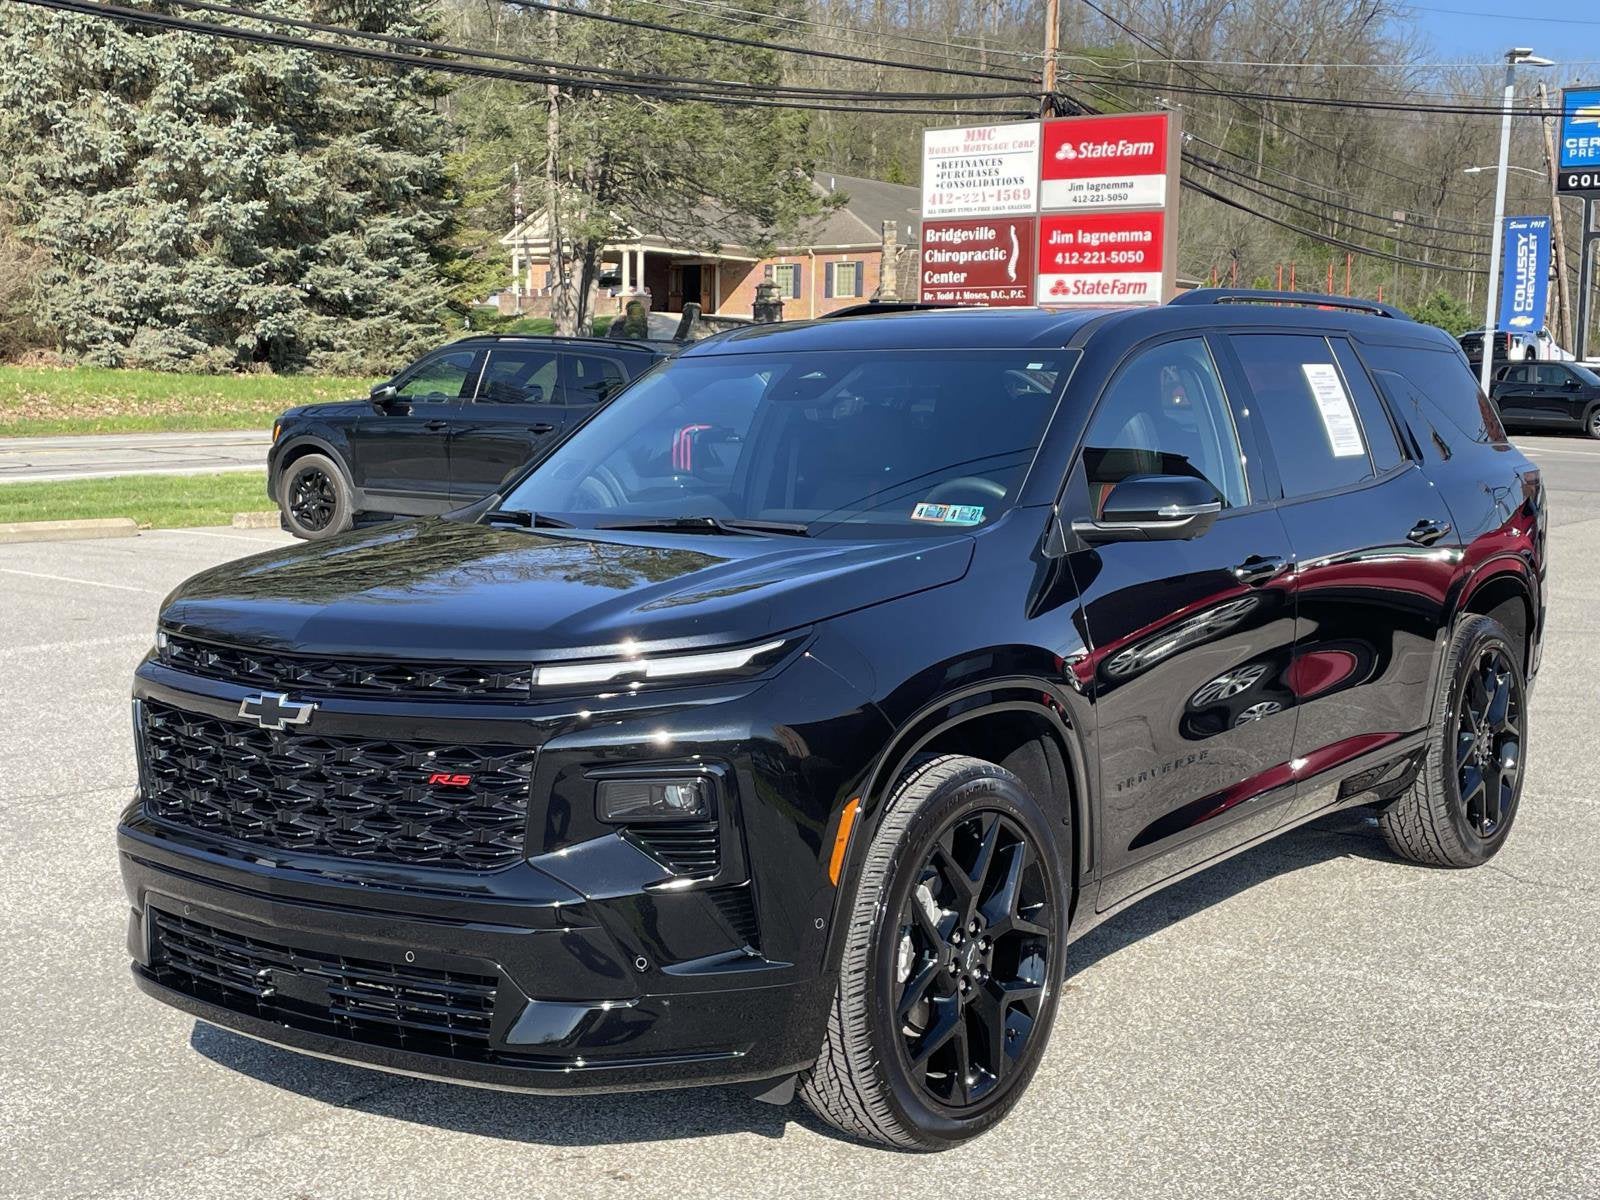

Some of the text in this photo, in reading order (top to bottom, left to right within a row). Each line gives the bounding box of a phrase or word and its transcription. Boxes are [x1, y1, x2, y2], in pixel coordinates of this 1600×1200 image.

[964, 128, 996, 142] MMC
[963, 142, 1009, 153] MORTGAGE
[941, 158, 1003, 170] REFINANCES
[941, 168, 1000, 179] PURCHASES
[940, 176, 1025, 189] CONSOLIDATIONS
[1568, 174, 1600, 187] COL
[1068, 183, 1084, 192] Jim
[1072, 193, 1129, 203] 412-221-5050
[926, 227, 996, 244] Bridgeville
[1048, 229, 1152, 246] Jim Iagnemma
[925, 247, 1007, 264] Chiropractic
[1055, 250, 1144, 264] 412-221-5050
[924, 270, 967, 284] Center
[1514, 233, 1528, 312] COLUSSY
[1525, 232, 1537, 311] CHEVROLET
[924, 292, 936, 301] Dr.
[937, 291, 954, 300] Todd
[917, 507, 924, 517] 4
[1117, 750, 1209, 792] TRAVERSE
[429, 774, 471, 786] RS
